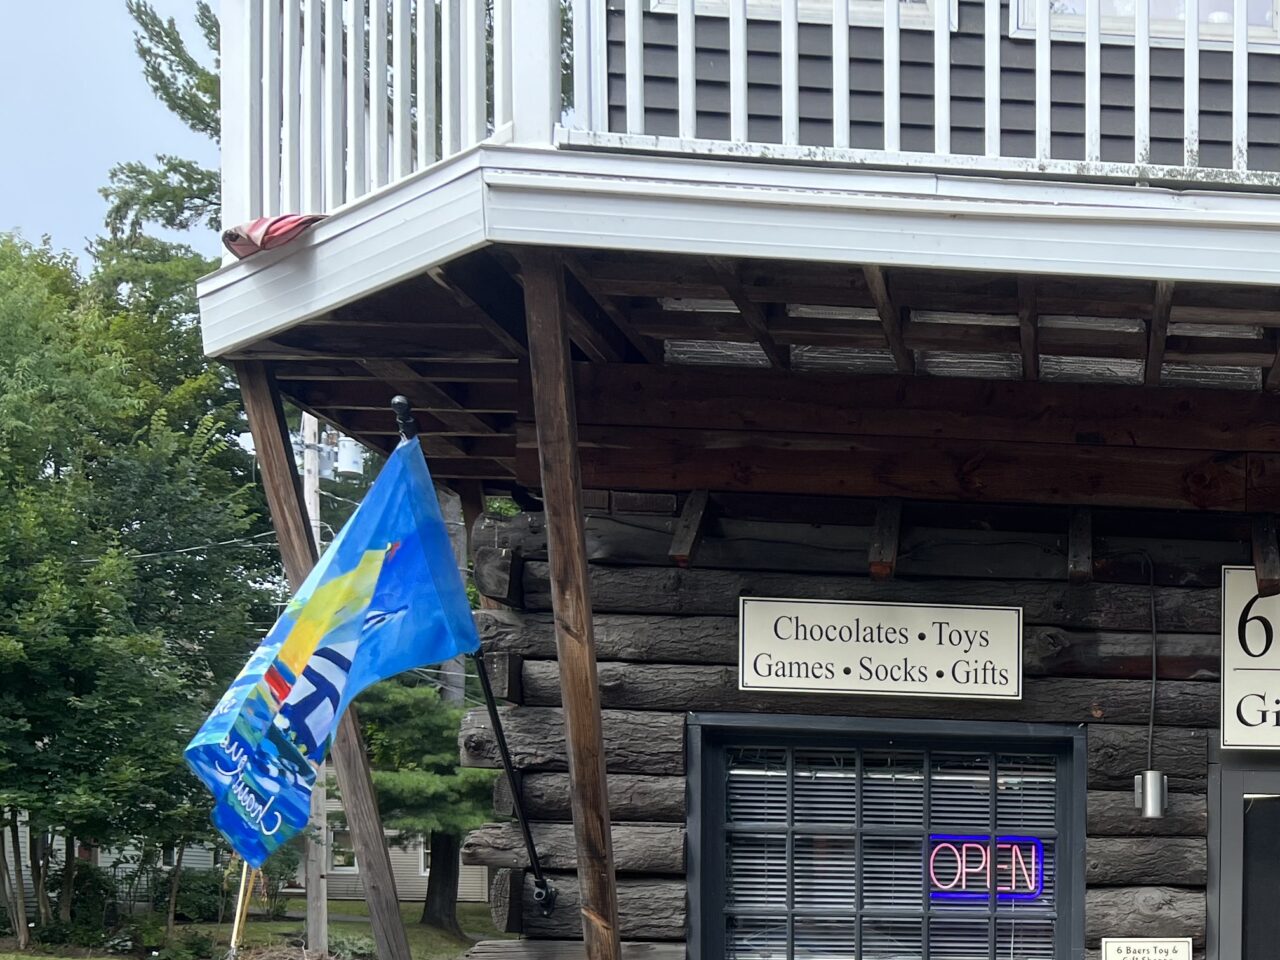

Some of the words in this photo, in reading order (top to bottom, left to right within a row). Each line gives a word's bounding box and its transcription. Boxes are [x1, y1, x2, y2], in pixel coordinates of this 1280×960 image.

[773, 614, 909, 647] Chocolates
[931, 621, 990, 653] Toys
[1237, 592, 1275, 658] 6
[752, 652, 835, 680] Games
[858, 656, 929, 684] Socks
[951, 659, 1009, 686] Gifts
[929, 843, 1036, 890] OPEN
[1116, 946, 1123, 954] 6
[1125, 946, 1150, 955] Baers
[1153, 946, 1169, 957] Toy
[1171, 945, 1178, 954] &
